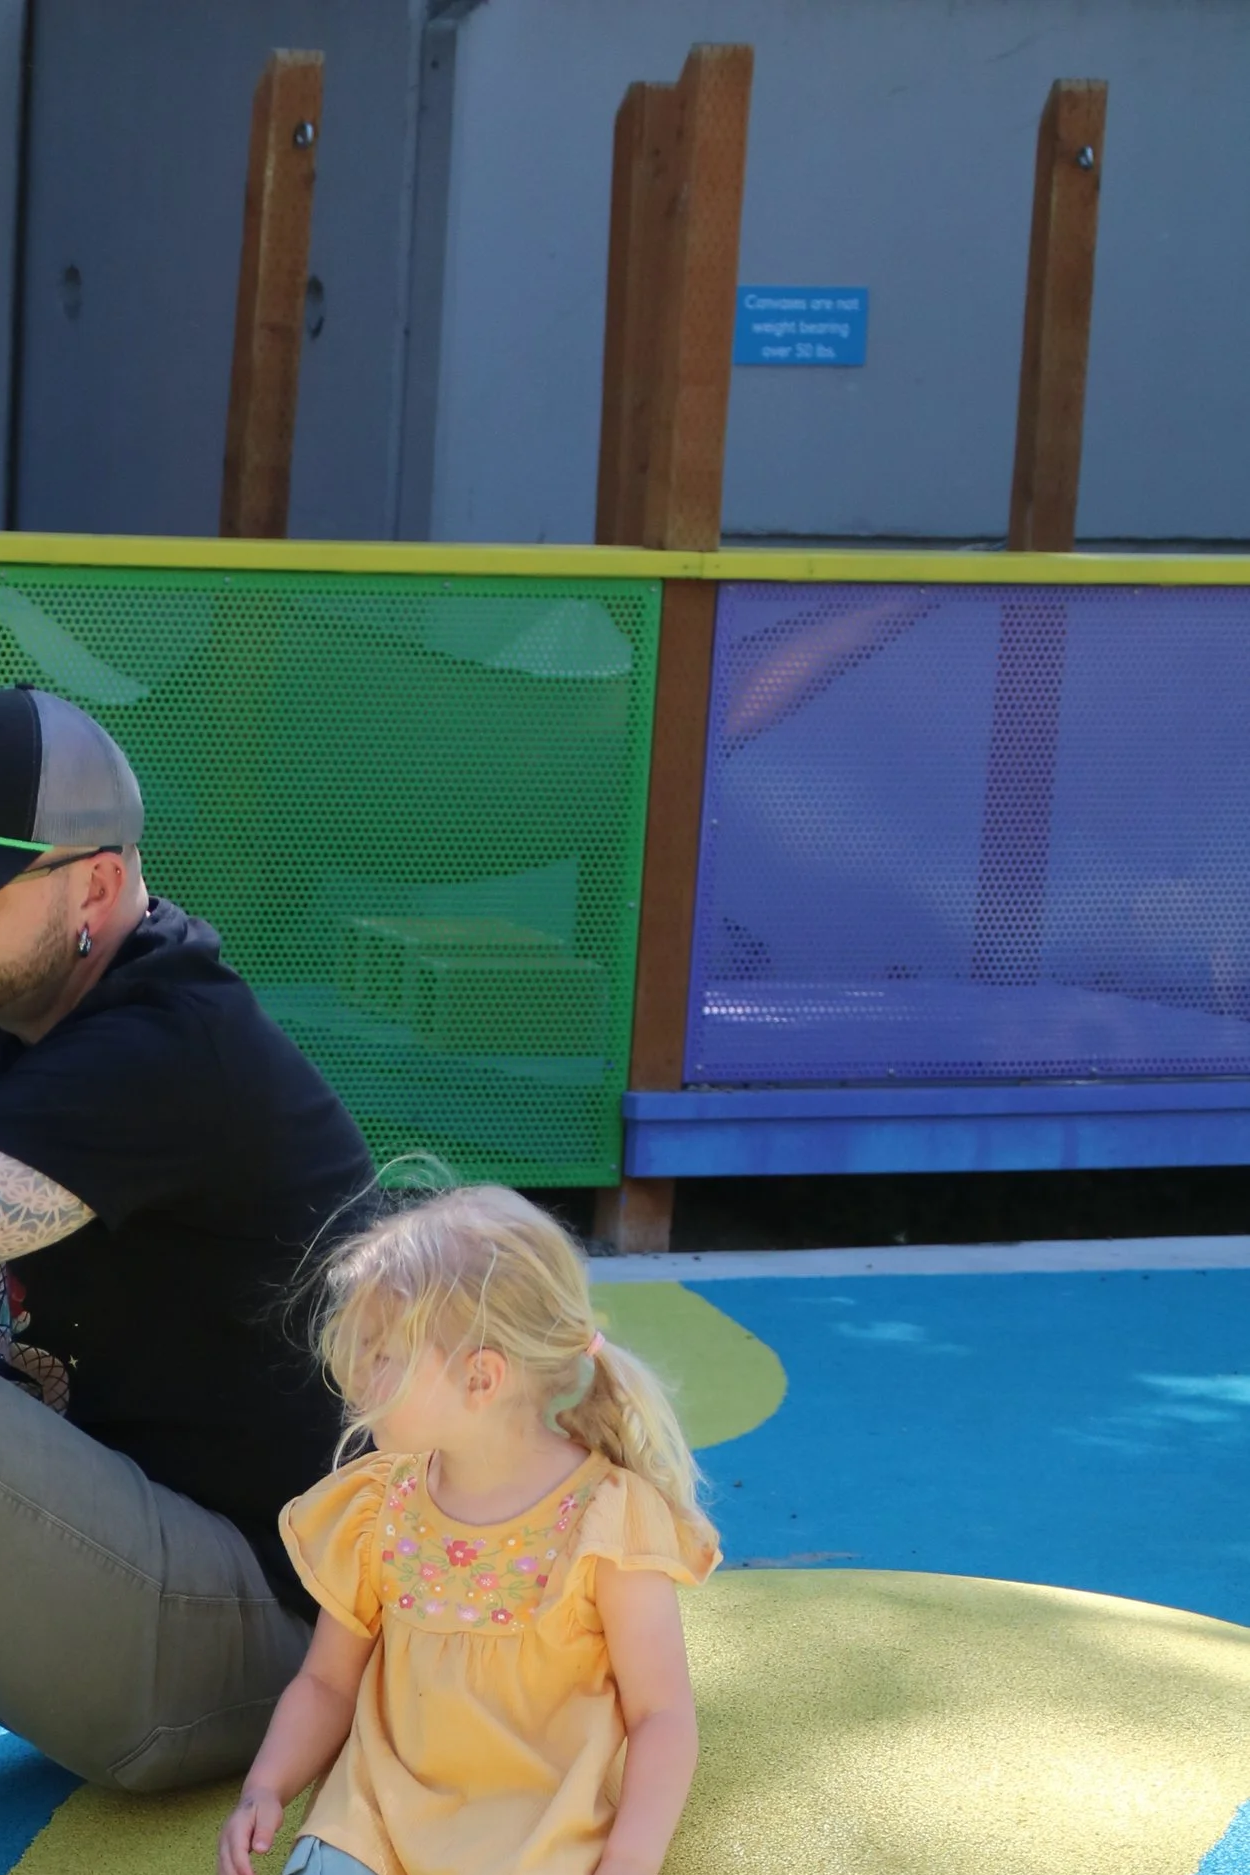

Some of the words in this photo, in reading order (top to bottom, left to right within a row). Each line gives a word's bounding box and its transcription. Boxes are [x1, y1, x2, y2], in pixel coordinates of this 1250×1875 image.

[744, 294, 807, 311] Canvases
[810, 298, 834, 311] are
[836, 297, 860, 311] not
[752, 321, 797, 338] weight
[799, 321, 850, 339] bearing
[761, 345, 793, 358] over
[795, 342, 814, 358] 50
